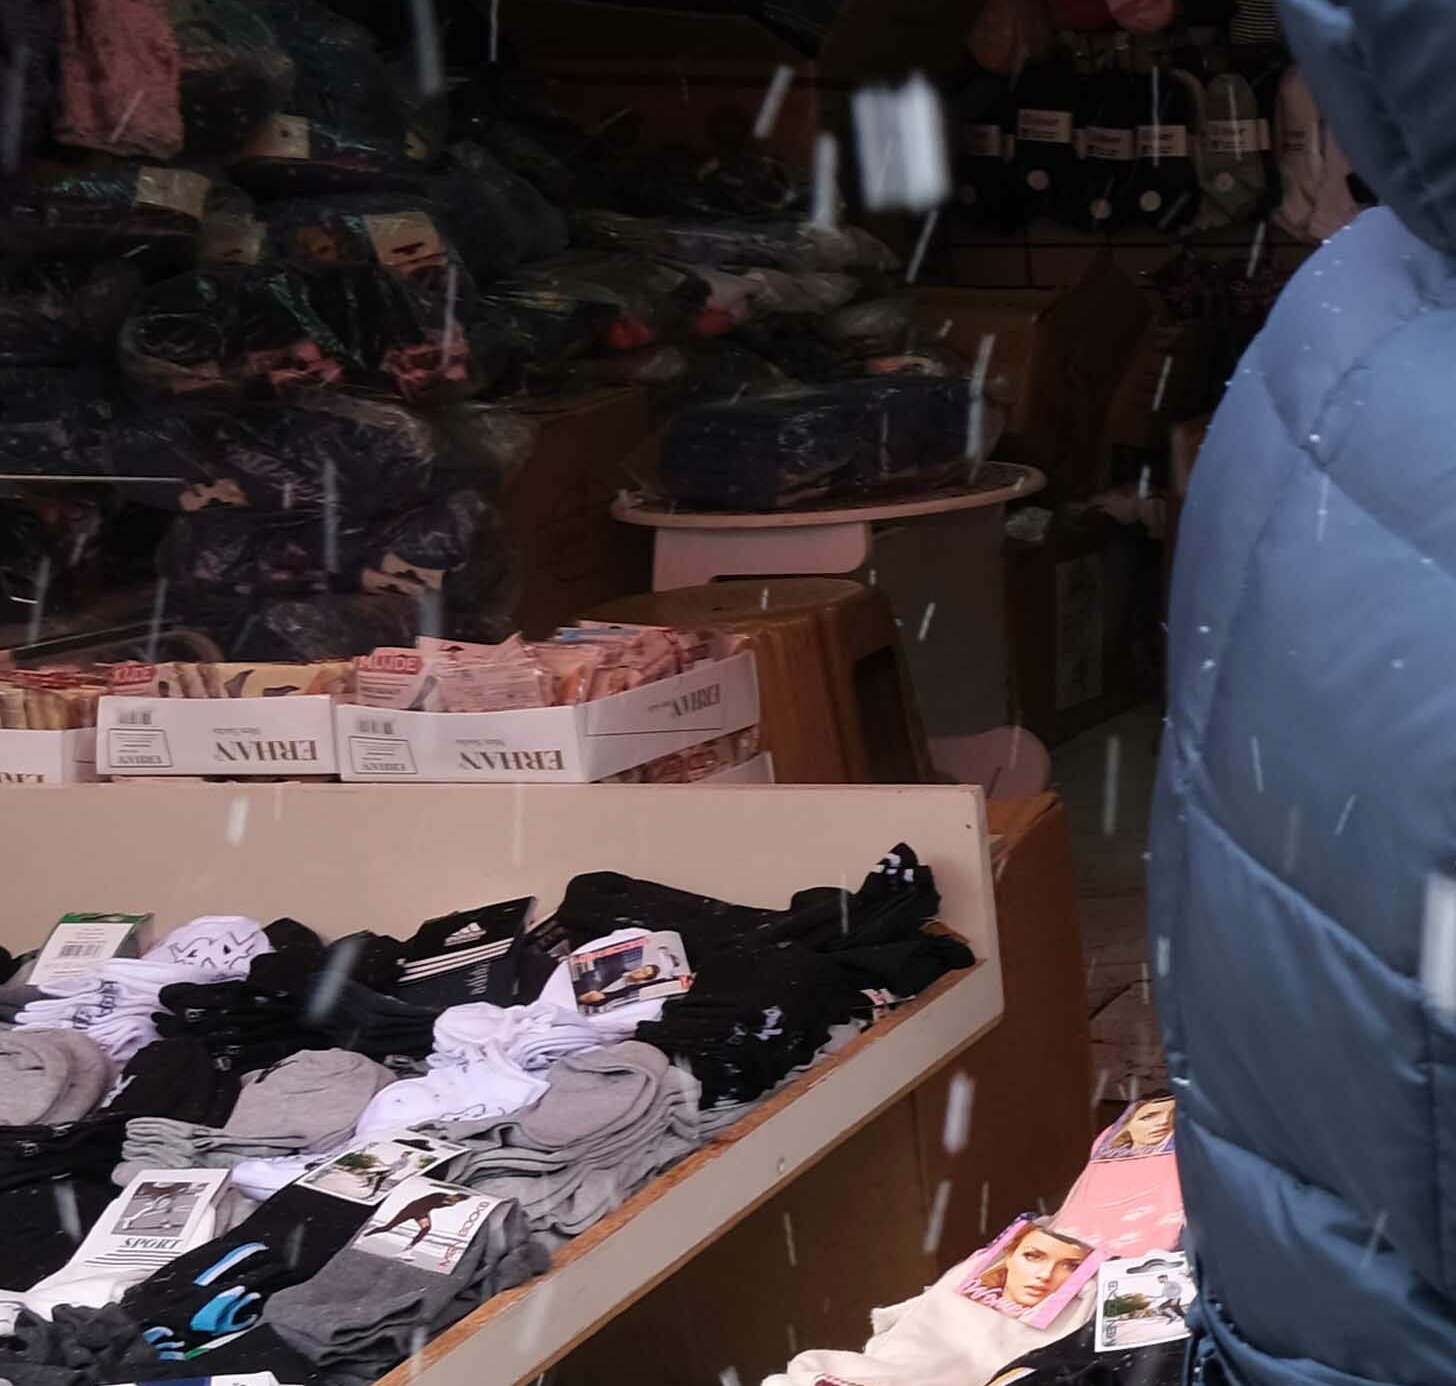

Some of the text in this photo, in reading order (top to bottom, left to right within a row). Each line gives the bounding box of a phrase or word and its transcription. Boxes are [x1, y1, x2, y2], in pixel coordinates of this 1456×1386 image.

[215, 740, 318, 762] ERHAN
[457, 749, 565, 771] ERHAN
[119, 1235, 184, 1251] SPORT
